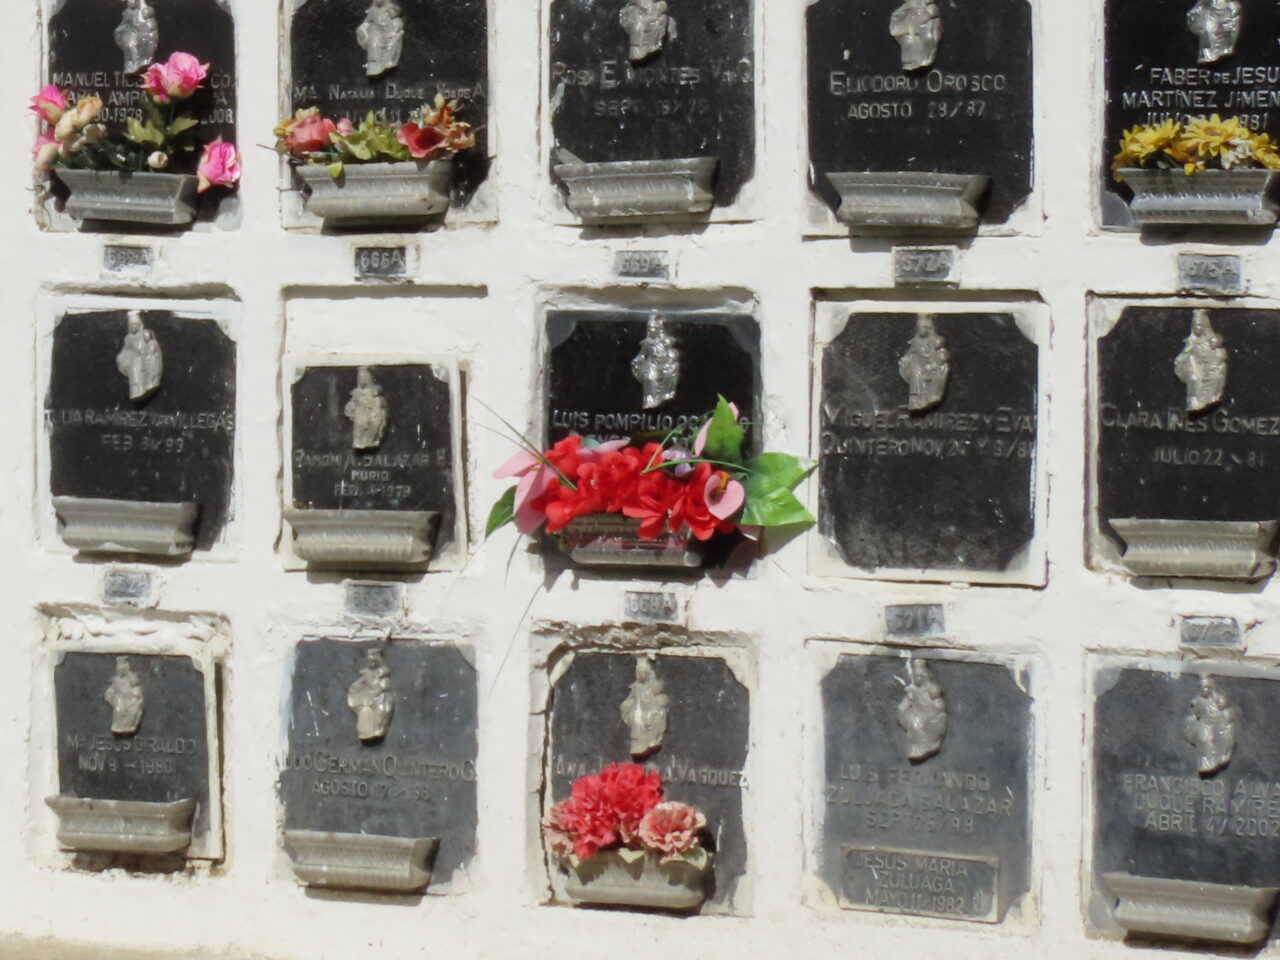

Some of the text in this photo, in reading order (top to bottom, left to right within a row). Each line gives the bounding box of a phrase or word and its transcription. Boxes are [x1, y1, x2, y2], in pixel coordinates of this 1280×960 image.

[51, 71, 111, 89] MANUEL
[926, 68, 1006, 93] OROSCO
[1150, 66, 1211, 86] FABER
[1231, 65, 1280, 85] JESU
[847, 101, 913, 120] AGOSTO
[1223, 89, 1280, 109] JIMEN
[552, 408, 673, 432] LUIS POMPILIO
[1100, 401, 1163, 430] CLARA
[1211, 408, 1280, 436] GOMEZ
[1133, 792, 1280, 820] DUQUE RAMIRE
[1143, 809, 1199, 833] ABRIL
[878, 871, 955, 895] ZULUAGA
